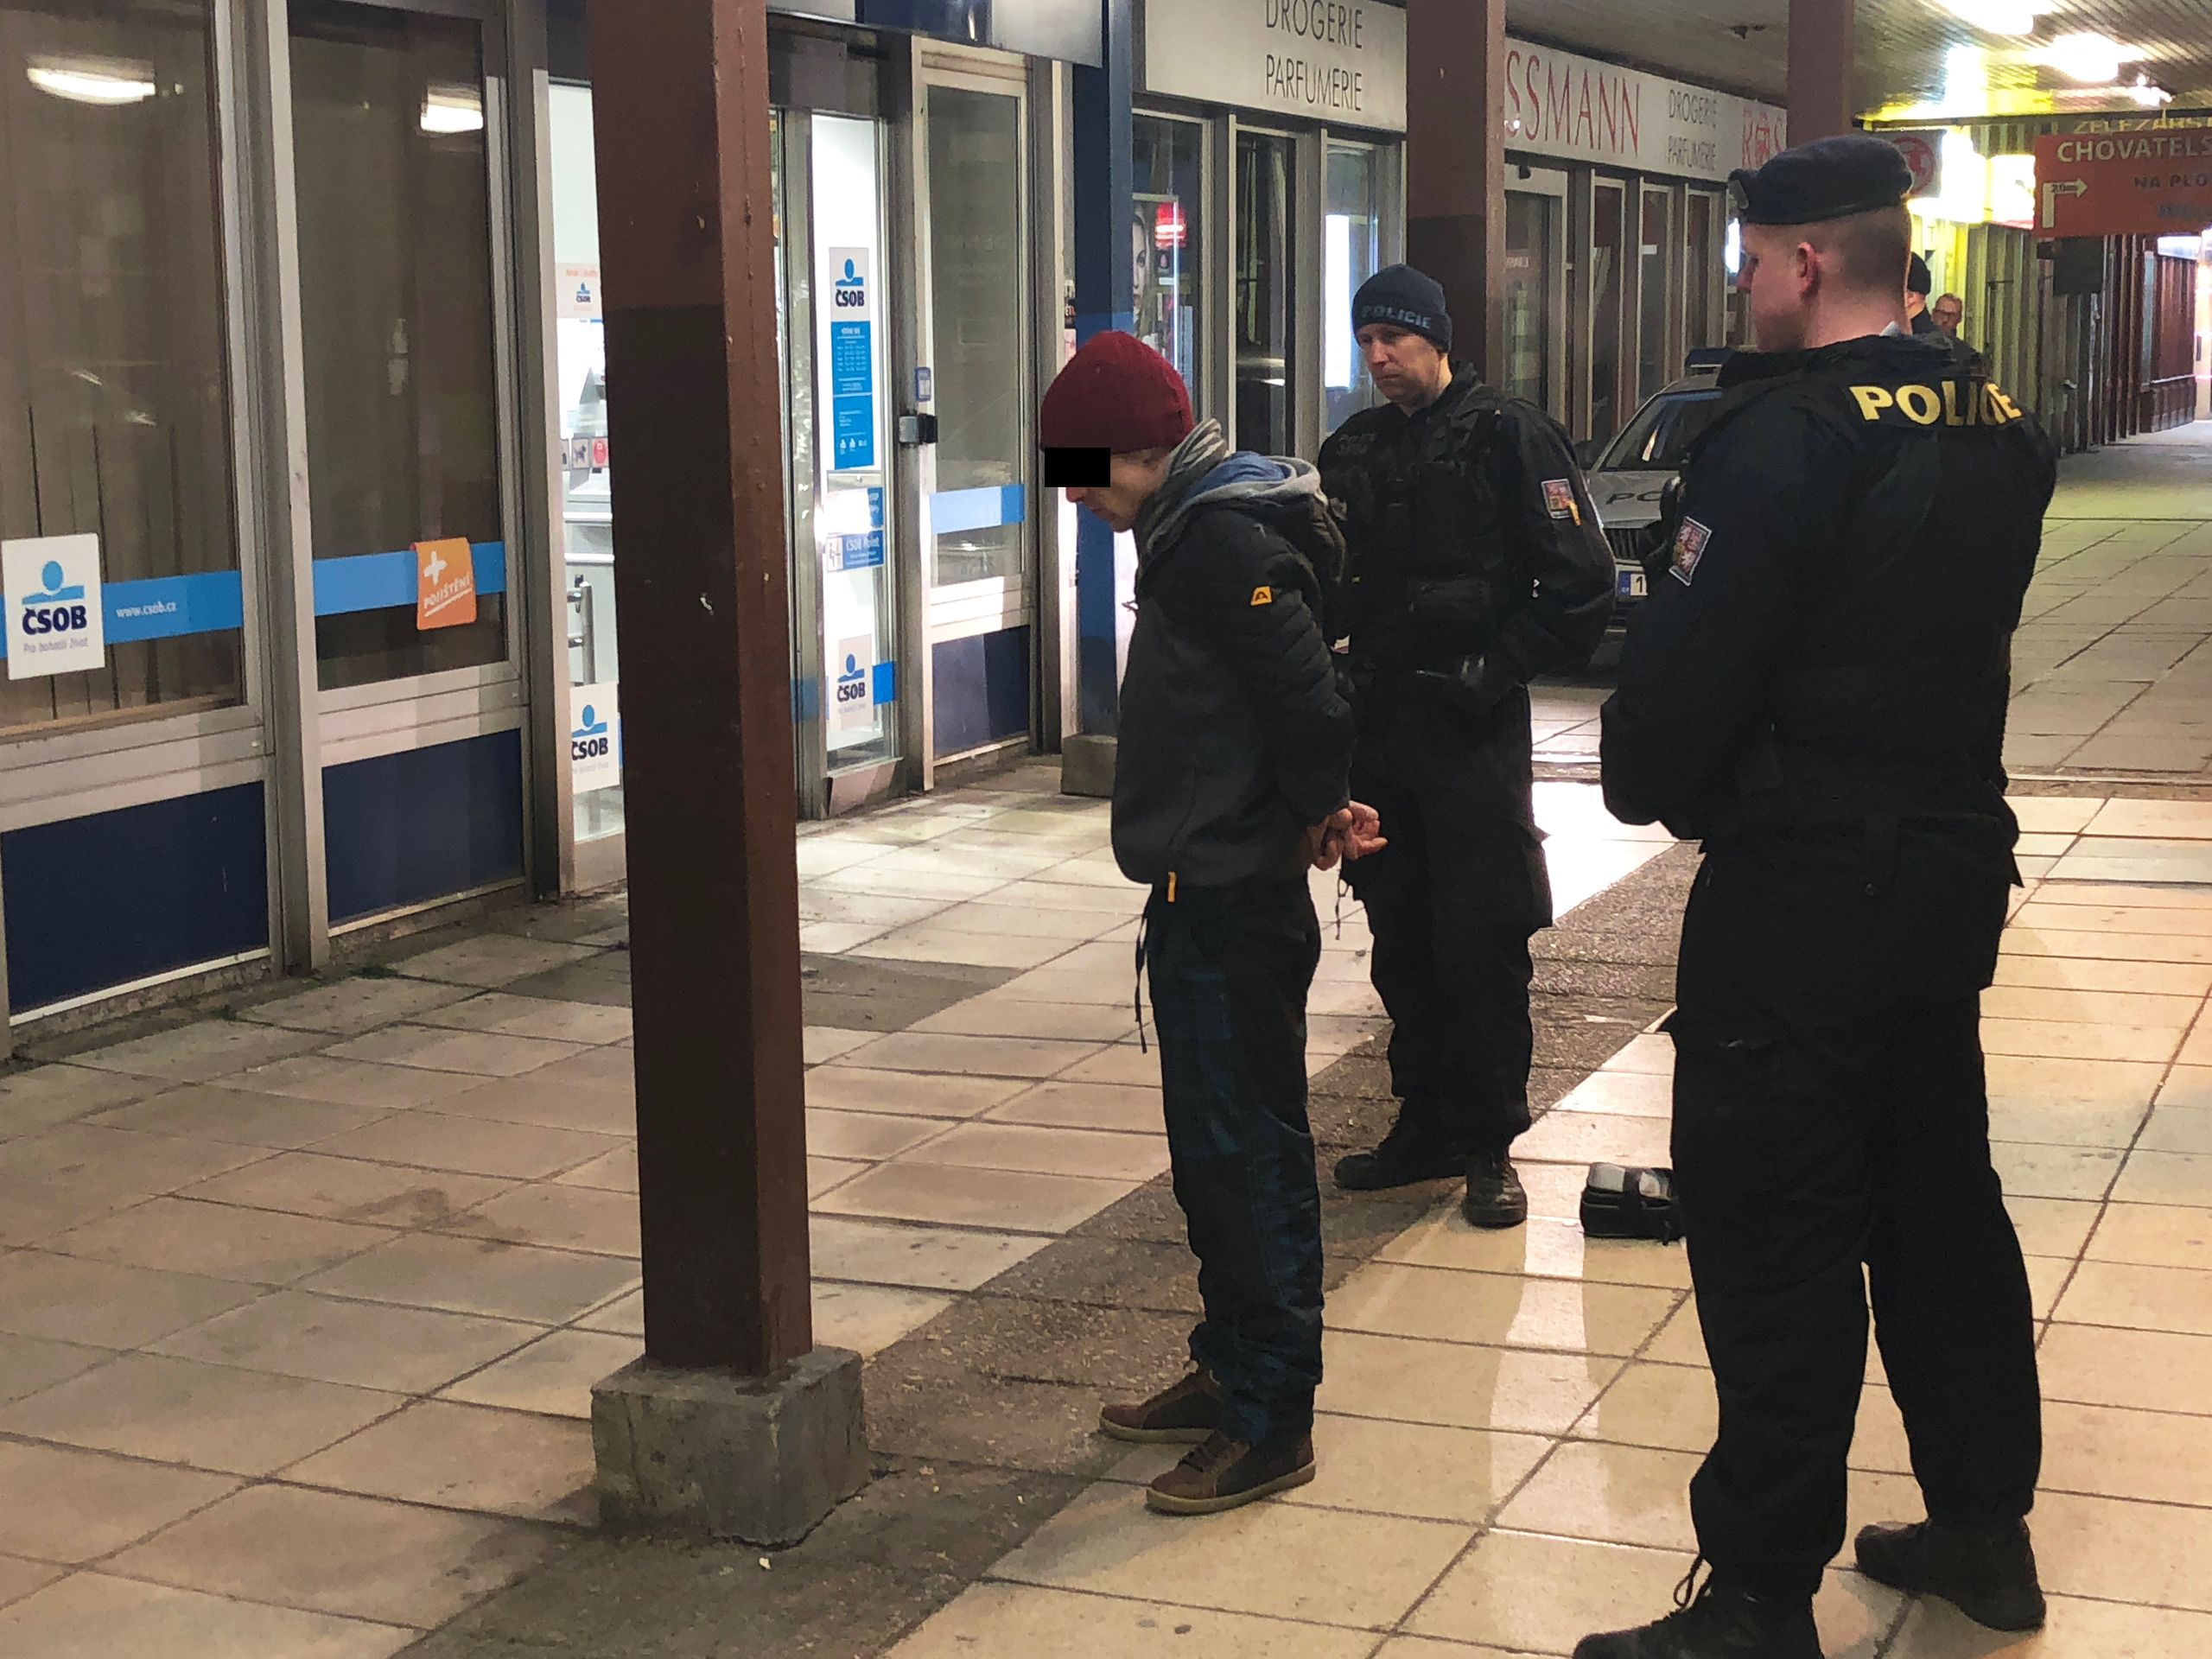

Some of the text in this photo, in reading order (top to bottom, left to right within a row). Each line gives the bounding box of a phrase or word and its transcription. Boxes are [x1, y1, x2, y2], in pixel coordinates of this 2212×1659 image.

[1266, 0, 1363, 49] DROGERIE
[1266, 54, 1362, 111] PARFUMERIE
[1669, 89, 1718, 130] DROGERIE
[2056, 135, 2212, 162] CHOVATELS
[2133, 175, 2161, 189] NA
[836, 289, 866, 308] ČSOB
[1362, 304, 1432, 329] POLICIE
[22, 605, 87, 635] ČSOB
[116, 601, 177, 619] www.csob.cz
[836, 682, 866, 702] ČSOB
